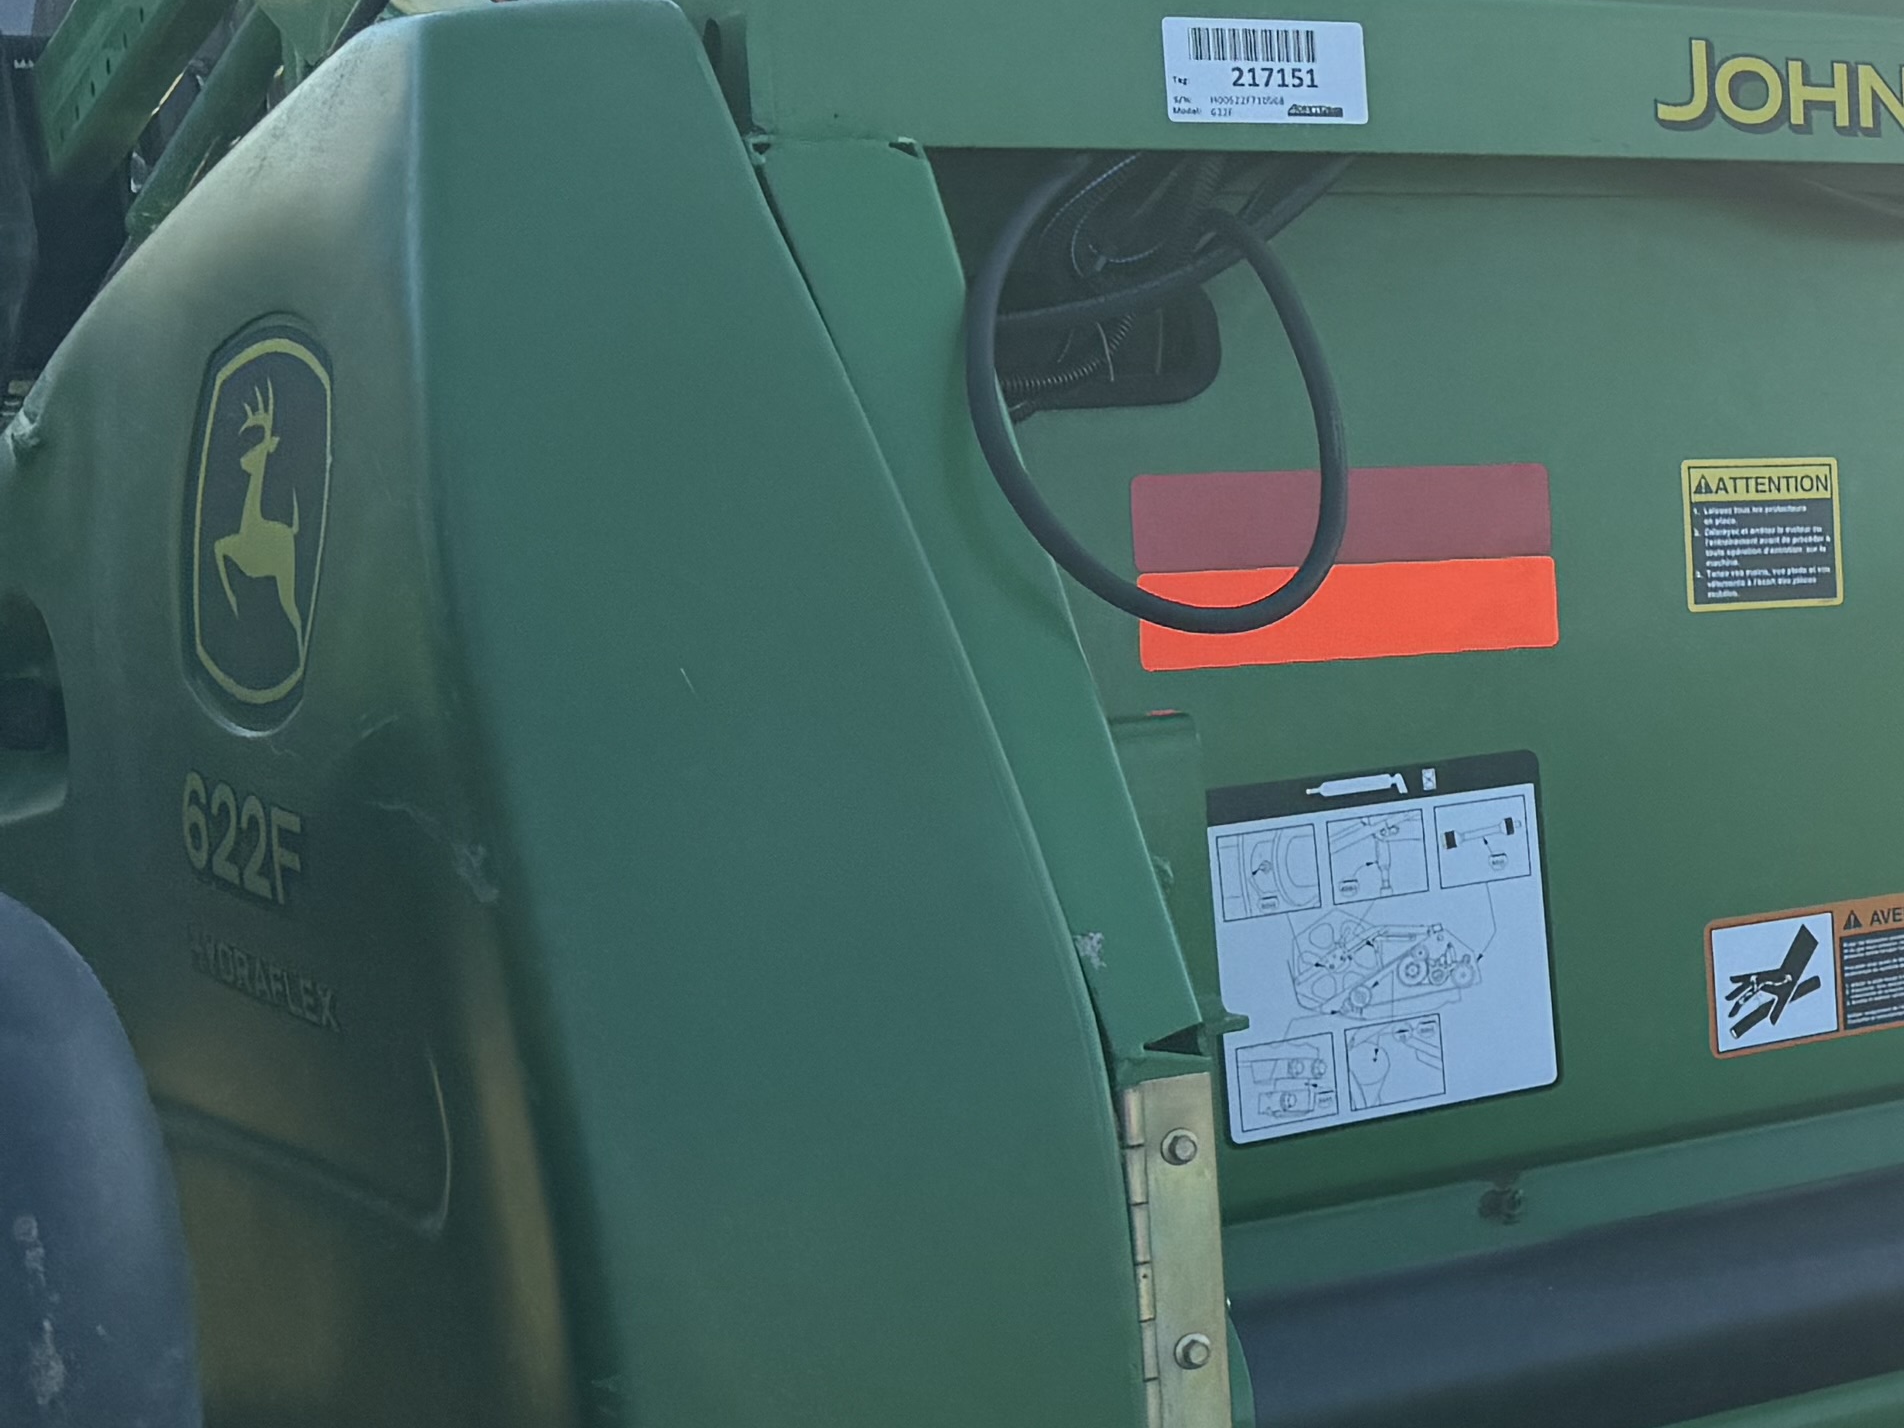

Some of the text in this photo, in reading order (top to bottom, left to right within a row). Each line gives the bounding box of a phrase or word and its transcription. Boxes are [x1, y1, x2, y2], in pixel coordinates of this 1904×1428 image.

[1231, 67, 1319, 89] 217151
[1715, 474, 1829, 494] ATTENTION
[182, 771, 301, 905] 622F
